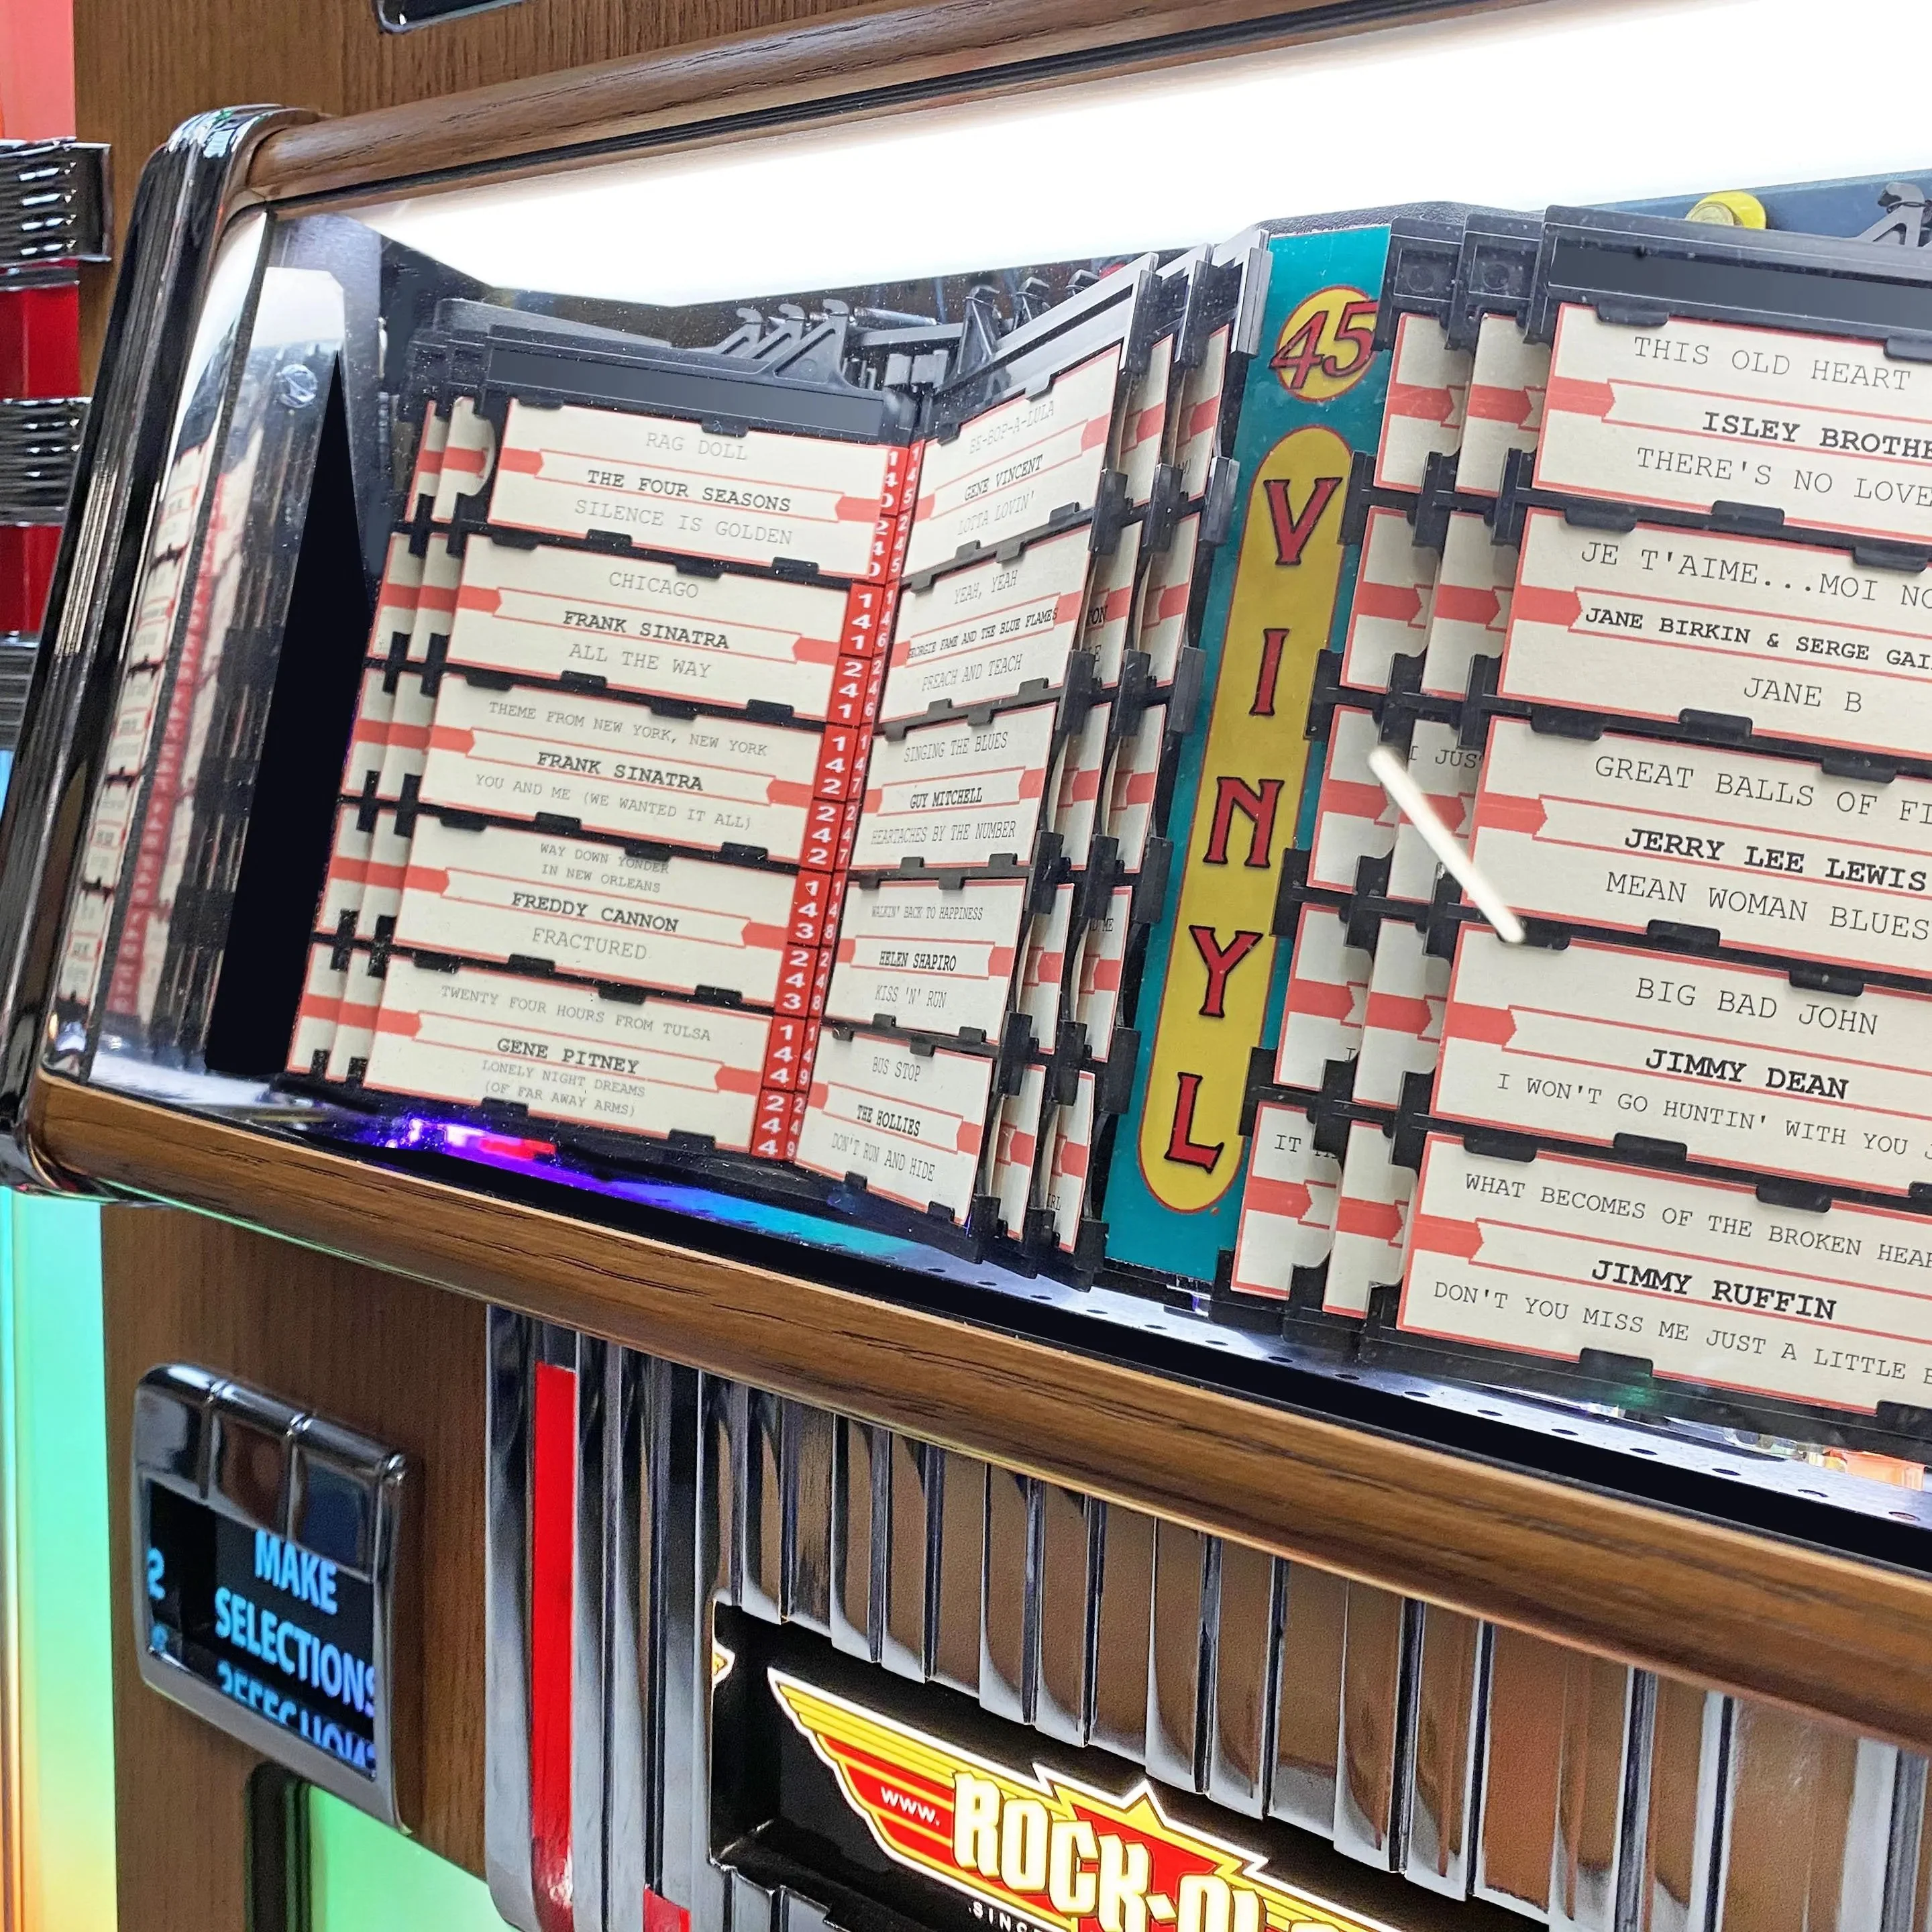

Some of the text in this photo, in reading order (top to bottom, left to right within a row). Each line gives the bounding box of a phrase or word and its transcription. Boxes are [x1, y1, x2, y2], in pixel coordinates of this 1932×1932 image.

[1269, 300, 1379, 389] 45
[1634, 336, 1911, 391] THIS OLD HEART
[1703, 411, 1801, 443] ISLEY
[646, 432, 747, 461] RAG DOLL
[588, 470, 791, 512] THE FOUR SEASONS
[965, 454, 1042, 500] GENE VINCENT
[1638, 447, 1932, 507] THERE'S NO LOVE
[575, 499, 792, 545] SILENCE IS GOLDEN
[1581, 541, 1619, 567] JE
[609, 572, 698, 598] CHICAGO
[954, 570, 1018, 604] YEAH, YEAH
[563, 610, 729, 649] FRANK SINATRA
[961, 608, 1058, 645] AND THE BLUE FLAMES
[1586, 607, 1870, 661] JANE BIRKIN & SERGE
[569, 643, 711, 678] ALL THE WAY
[922, 653, 1023, 691] PREACH AND TEACH
[1744, 677, 1863, 714] JANE B
[490, 702, 767, 756] THEME FROM NEW YORK, NEW YORK
[904, 732, 1008, 762] SINGING THE BLUES
[537, 752, 703, 791] FRANK SINATRA
[1595, 756, 1695, 790] GREAT
[1715, 773, 1814, 807] BALLS
[1837, 790, 1877, 815] OF
[476, 774, 751, 830] YOU AND ME (WE WANTED IT ALL)
[910, 787, 982, 809] GUY MITCHELL
[871, 820, 1016, 845] HEARTACHES BY THE NUMBER
[1164, 478, 1342, 1174] VINYL
[541, 843, 669, 874] WAY DOWN YONDER
[1625, 828, 1927, 892] JERRY LEE LEWIS
[542, 864, 661, 893] IN NEW ORLEANS
[511, 892, 679, 932] FREDDY CANNON
[939, 907, 983, 920] HAPPINESS
[1605, 872, 1929, 941] MEAN WOMAN BLUES
[533, 928, 647, 960] FRACTURED
[879, 951, 957, 971] HELEN SHAPIRO
[442, 985, 710, 1041] TWENTY FOUR HOURS FROM TULSA
[875, 985, 947, 1008] KISS 'N' RUN
[1636, 977, 1878, 1036] BIG BAD JOHN
[497, 1038, 639, 1075] GENE PITNEY
[872, 1057, 921, 1082] BUS STOP
[1646, 1049, 1849, 1100] JIMMY DEAN
[482, 1060, 645, 1097] LONELY NIGHT DREAMS
[485, 1081, 636, 1118] (OF FAR AWAY ARMS)
[1497, 1074, 1510, 1091] I
[1527, 1078, 1602, 1105] WON'T
[1618, 1093, 1648, 1112] GO
[1663, 1099, 1766, 1130] HUNTIN'
[1785, 1119, 1846, 1146] WITH
[1863, 1132, 1909, 1155] YOU
[857, 1105, 920, 1136] THE HOLLIES
[831, 1133, 936, 1182] DON'T RUN AND HIDE
[1275, 1134, 1301, 1152] IT
[1465, 1173, 1862, 1256] WHAT BECOMES OF THE BROKEN
[1591, 1259, 1837, 1321] JIMMY RUFFIN
[1434, 1281, 1509, 1310] DON'T
[1524, 1297, 1568, 1322] YOU
[1582, 1305, 1643, 1334] MISS
[1658, 1321, 1688, 1341] ME
[1705, 1328, 1766, 1356] JUST
[1781, 1342, 1797, 1361] A
[1814, 1348, 1906, 1386] LITTLE
[255, 1528, 337, 1615] MAKE
[973, 1901, 1043, 1932] SINC
